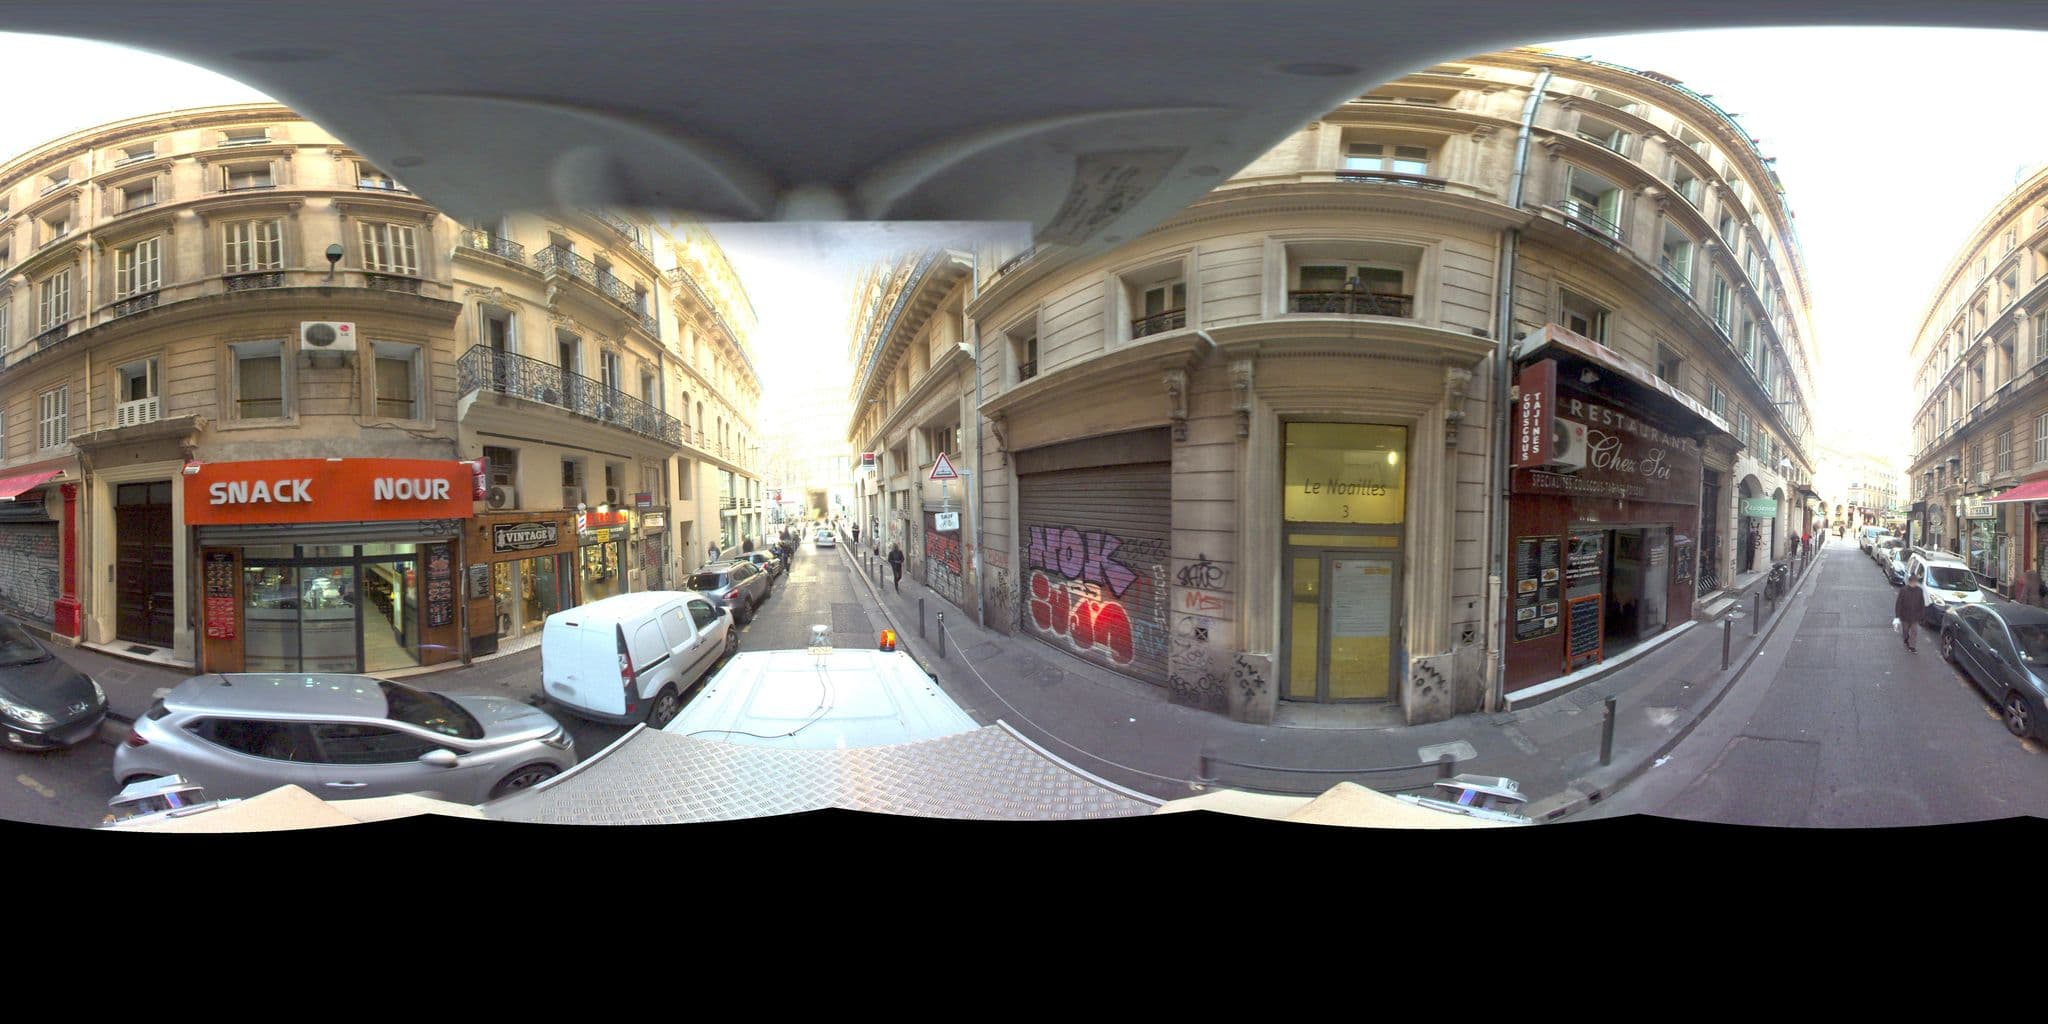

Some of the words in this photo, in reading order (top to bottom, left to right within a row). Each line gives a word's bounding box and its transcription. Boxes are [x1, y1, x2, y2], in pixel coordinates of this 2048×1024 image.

[1522, 393, 1530, 461] COUSCOUS
[1532, 392, 1541, 454] TAJINES
[1570, 398, 1687, 451] RESTAURANT
[1586, 429, 1635, 472] Chez
[1640, 448, 1672, 479] Soi
[209, 478, 313, 505] SNACK
[374, 477, 450, 501] NOUR
[1304, 478, 1320, 494] Le
[1326, 477, 1386, 496] Noailles
[1342, 504, 1350, 518] 3
[506, 530, 547, 542] VINTAGE
